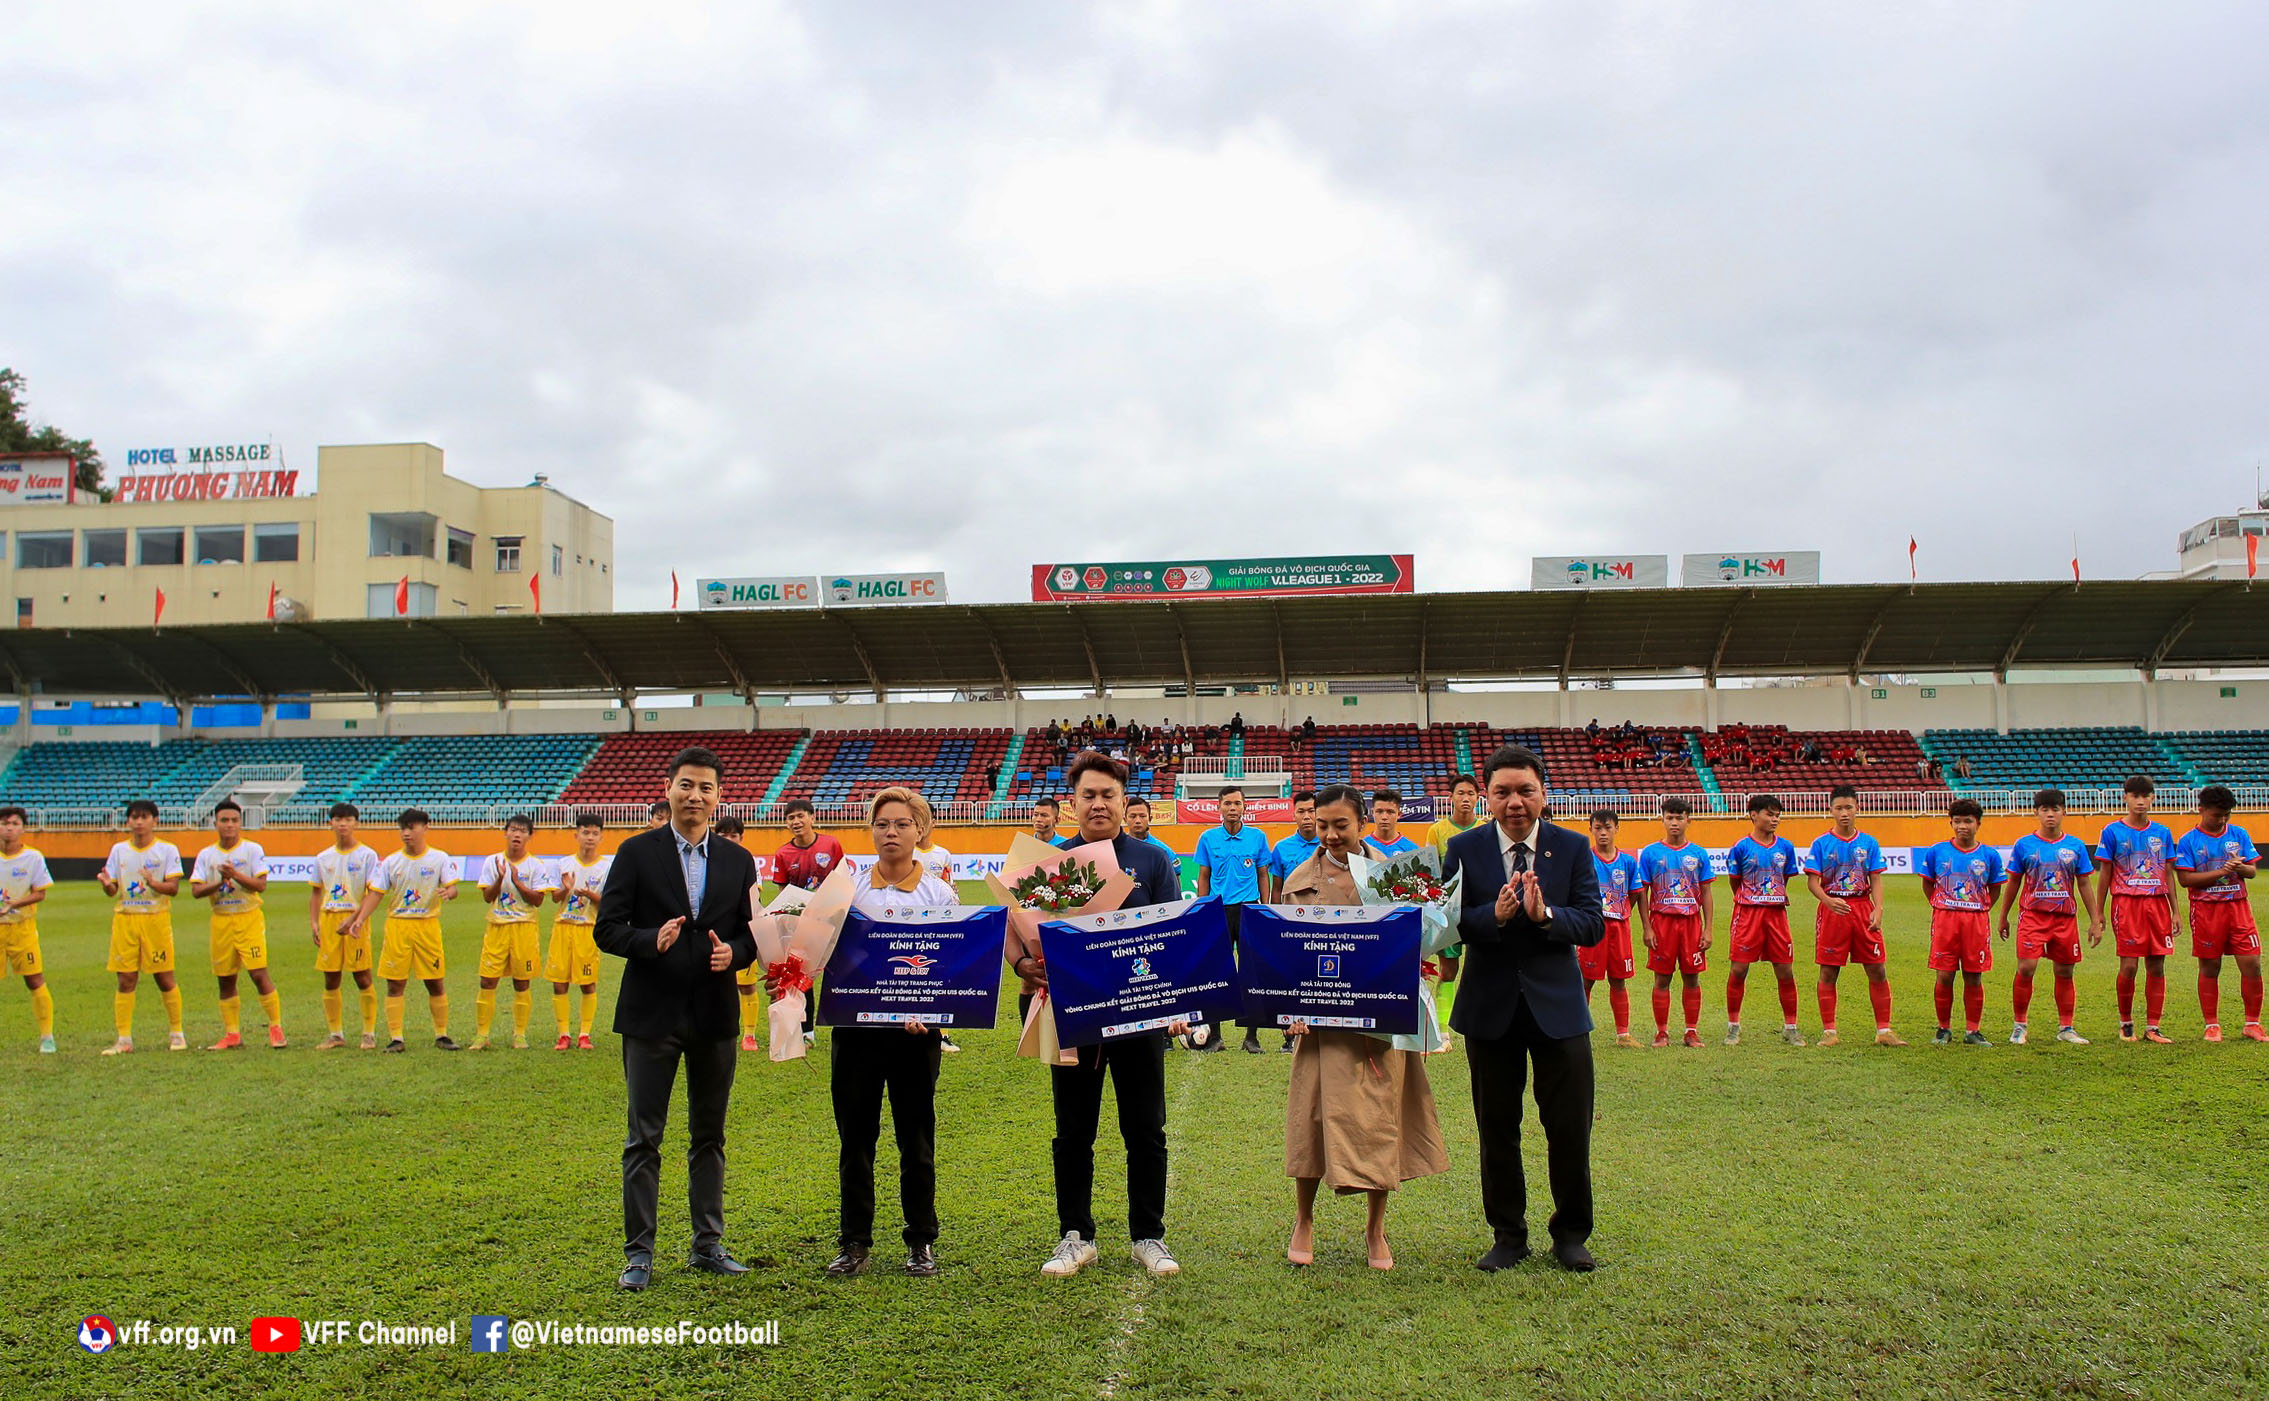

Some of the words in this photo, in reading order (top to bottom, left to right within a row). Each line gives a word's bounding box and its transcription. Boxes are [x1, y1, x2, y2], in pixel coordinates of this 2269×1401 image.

[128, 448, 177, 465] HOTEL
[188, 444, 270, 463] MASSAGE
[26, 474, 64, 489] Nam
[112, 472, 230, 503] PHƯƠNG
[236, 470, 299, 498] NAM
[1229, 566, 1246, 575] GIẢI
[1249, 565, 1272, 574] BÓNG
[1275, 564, 1287, 574] ĐÁ
[1290, 564, 1302, 573] VÔ
[1305, 565, 1325, 575] ĐỊCH
[1328, 561, 1352, 572] QUỐC
[1593, 562, 1634, 580] HSM
[1744, 558, 1785, 577] HSM
[1216, 577, 1241, 588] NIGHT
[1244, 576, 1268, 586] WOLF
[1271, 574, 1333, 585] V.LEAGUE
[1352, 573, 1383, 583] 2022
[732, 584, 780, 601] HAGL
[784, 584, 808, 600] FC
[858, 580, 907, 598] HAGL
[910, 579, 936, 596] FC
[1415, 806, 1430, 814] TIN
[890, 940, 912, 950] KÍNH
[915, 940, 939, 952] TẶNG
[1304, 940, 1328, 951] KÍNH
[1329, 941, 1356, 953] TẶNG
[2165, 936, 2173, 948] 8
[2249, 934, 2259, 948] 11
[152, 951, 166, 963] 24
[250, 946, 261, 958] 12
[1112, 946, 1137, 958] KÍNH
[1137, 942, 1165, 955] TẶNG
[1873, 944, 1880, 956] 4
[1980, 950, 1985, 964] 3
[28, 952, 34, 964] 9
[432, 958, 440, 970] 4
[1692, 951, 1703, 966] 25
[583, 964, 592, 976] 16
[910, 967, 916, 975] &
[832, 986, 847, 994] VÒNG
[870, 986, 881, 994] KẾT
[894, 987, 912, 995] BÓNG
[913, 987, 922, 995] ĐÁ
[923, 987, 931, 995] VÔ
[931, 989, 946, 997] ĐỊCH
[958, 987, 976, 996] QUỐC
[1064, 1005, 1083, 1014] VÒNG
[1083, 1001, 1106, 1011] CHUNG
[1106, 997, 1118, 1007] KẾT
[1119, 995, 1132, 1005] GIẢI
[1133, 993, 1151, 1002] BÓNG
[1152, 990, 1161, 999] ĐÁ
[1161, 988, 1171, 998] VÔ
[1171, 987, 1187, 997] ĐỊCH
[1187, 985, 1198, 993] U15
[1198, 980, 1217, 991] QUỐC
[1217, 980, 1228, 988] GIA
[1248, 987, 1265, 995] VÒNG
[1288, 987, 1300, 996] KẾT
[1300, 989, 1313, 997] GIẢI
[1314, 989, 1332, 997] BÓNG
[1332, 990, 1341, 998] ĐÁ
[1342, 990, 1351, 998] VÔ
[1351, 992, 1366, 1000] ĐỊCH
[1378, 991, 1396, 1000] QUỐC
[1122, 1004, 1136, 1012] NEXT
[1139, 999, 1160, 1009] TRAVEL
[1161, 997, 1176, 1005] 2022
